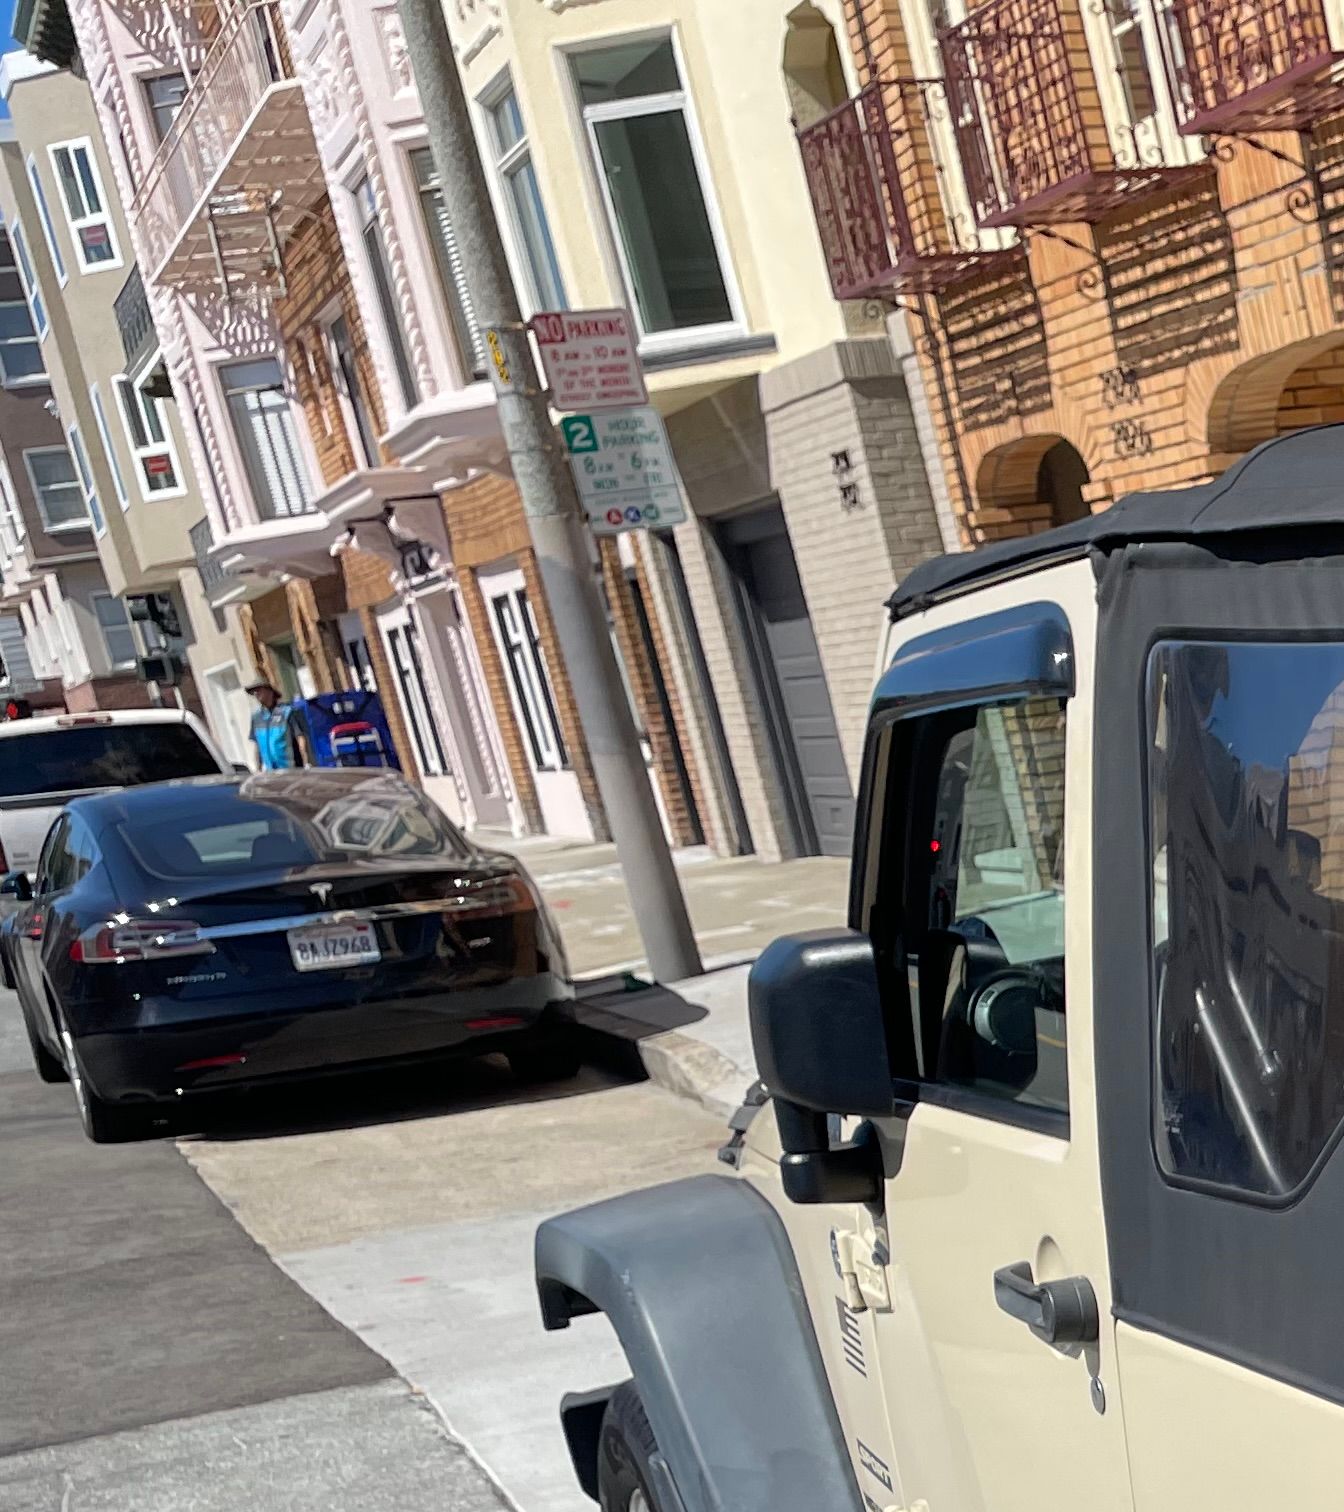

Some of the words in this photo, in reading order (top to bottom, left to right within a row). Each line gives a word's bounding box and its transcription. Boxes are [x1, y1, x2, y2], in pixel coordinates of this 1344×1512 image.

[566, 317, 625, 338] PARKING
[569, 422, 594, 449] 2
[602, 430, 660, 446] PARKING
[631, 453, 642, 471] 6
